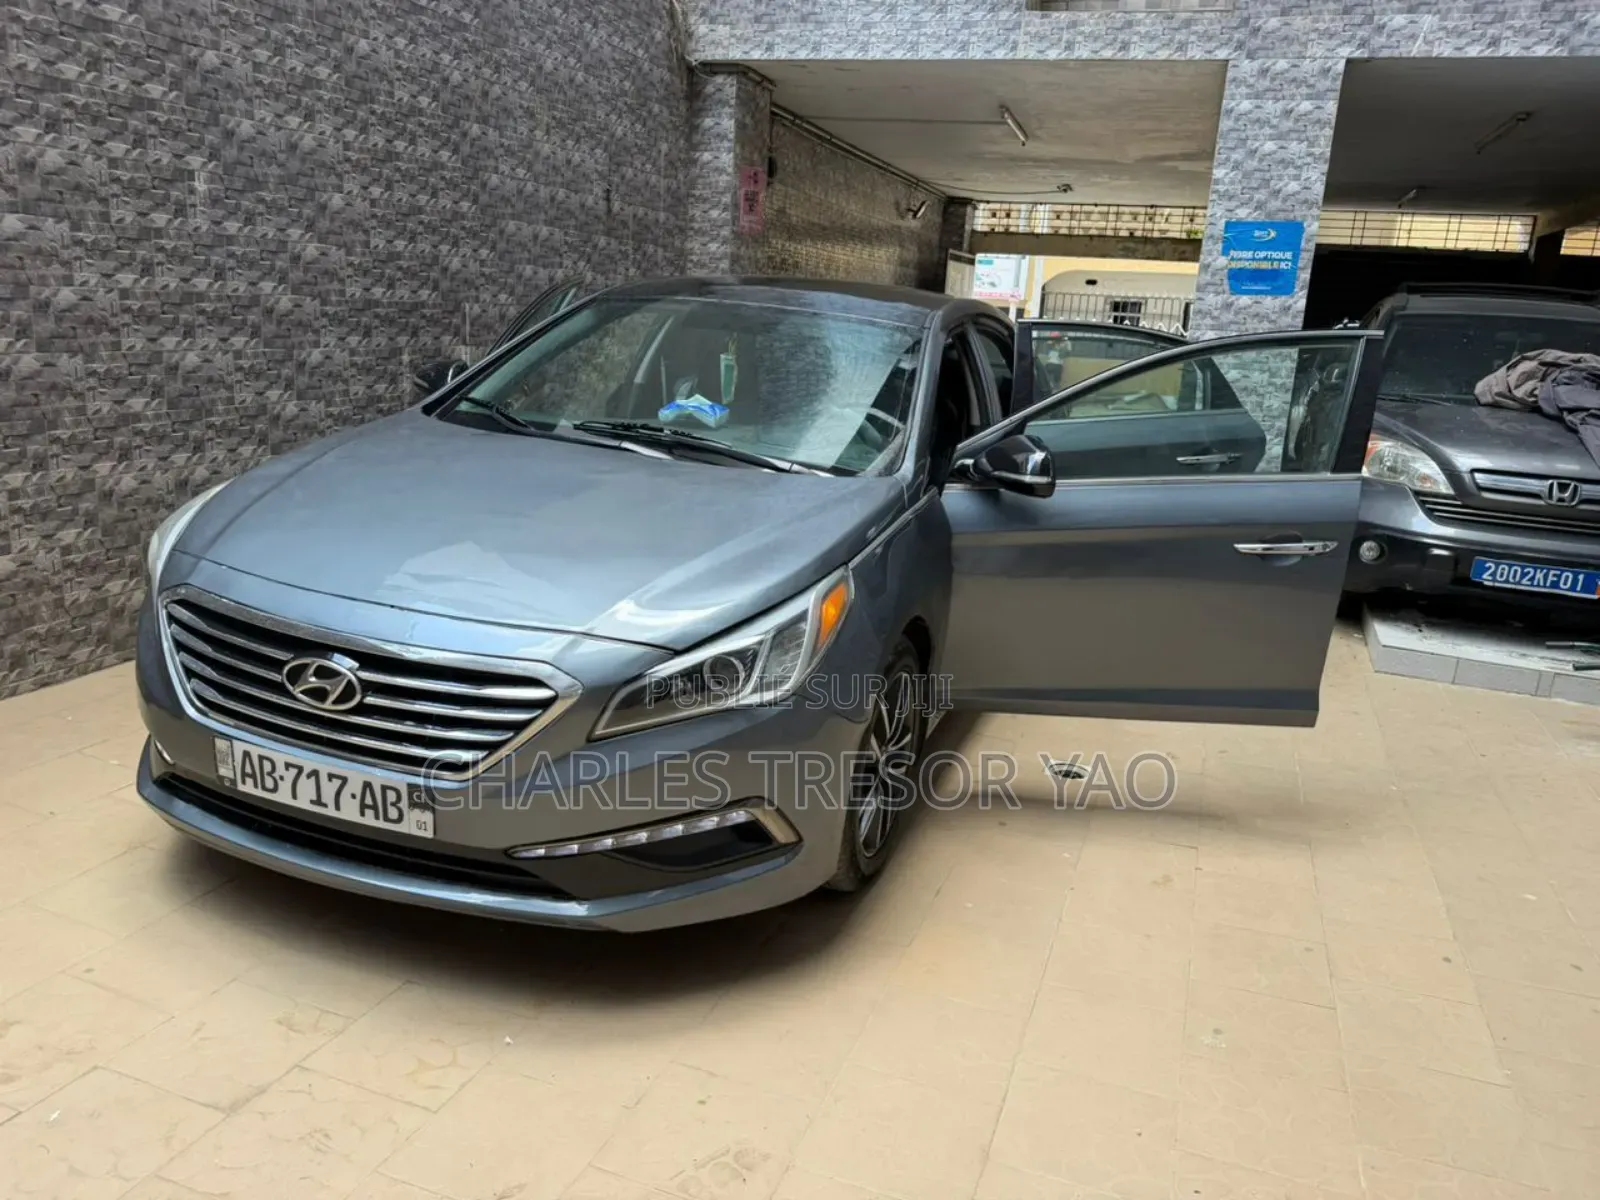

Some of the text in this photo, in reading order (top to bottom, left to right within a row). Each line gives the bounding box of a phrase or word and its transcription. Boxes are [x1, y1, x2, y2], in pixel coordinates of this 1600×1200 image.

[1254, 250, 1293, 260] OPTIQUE
[1482, 562, 1585, 591] 2002KF01
[415, 819, 428, 832] 01
